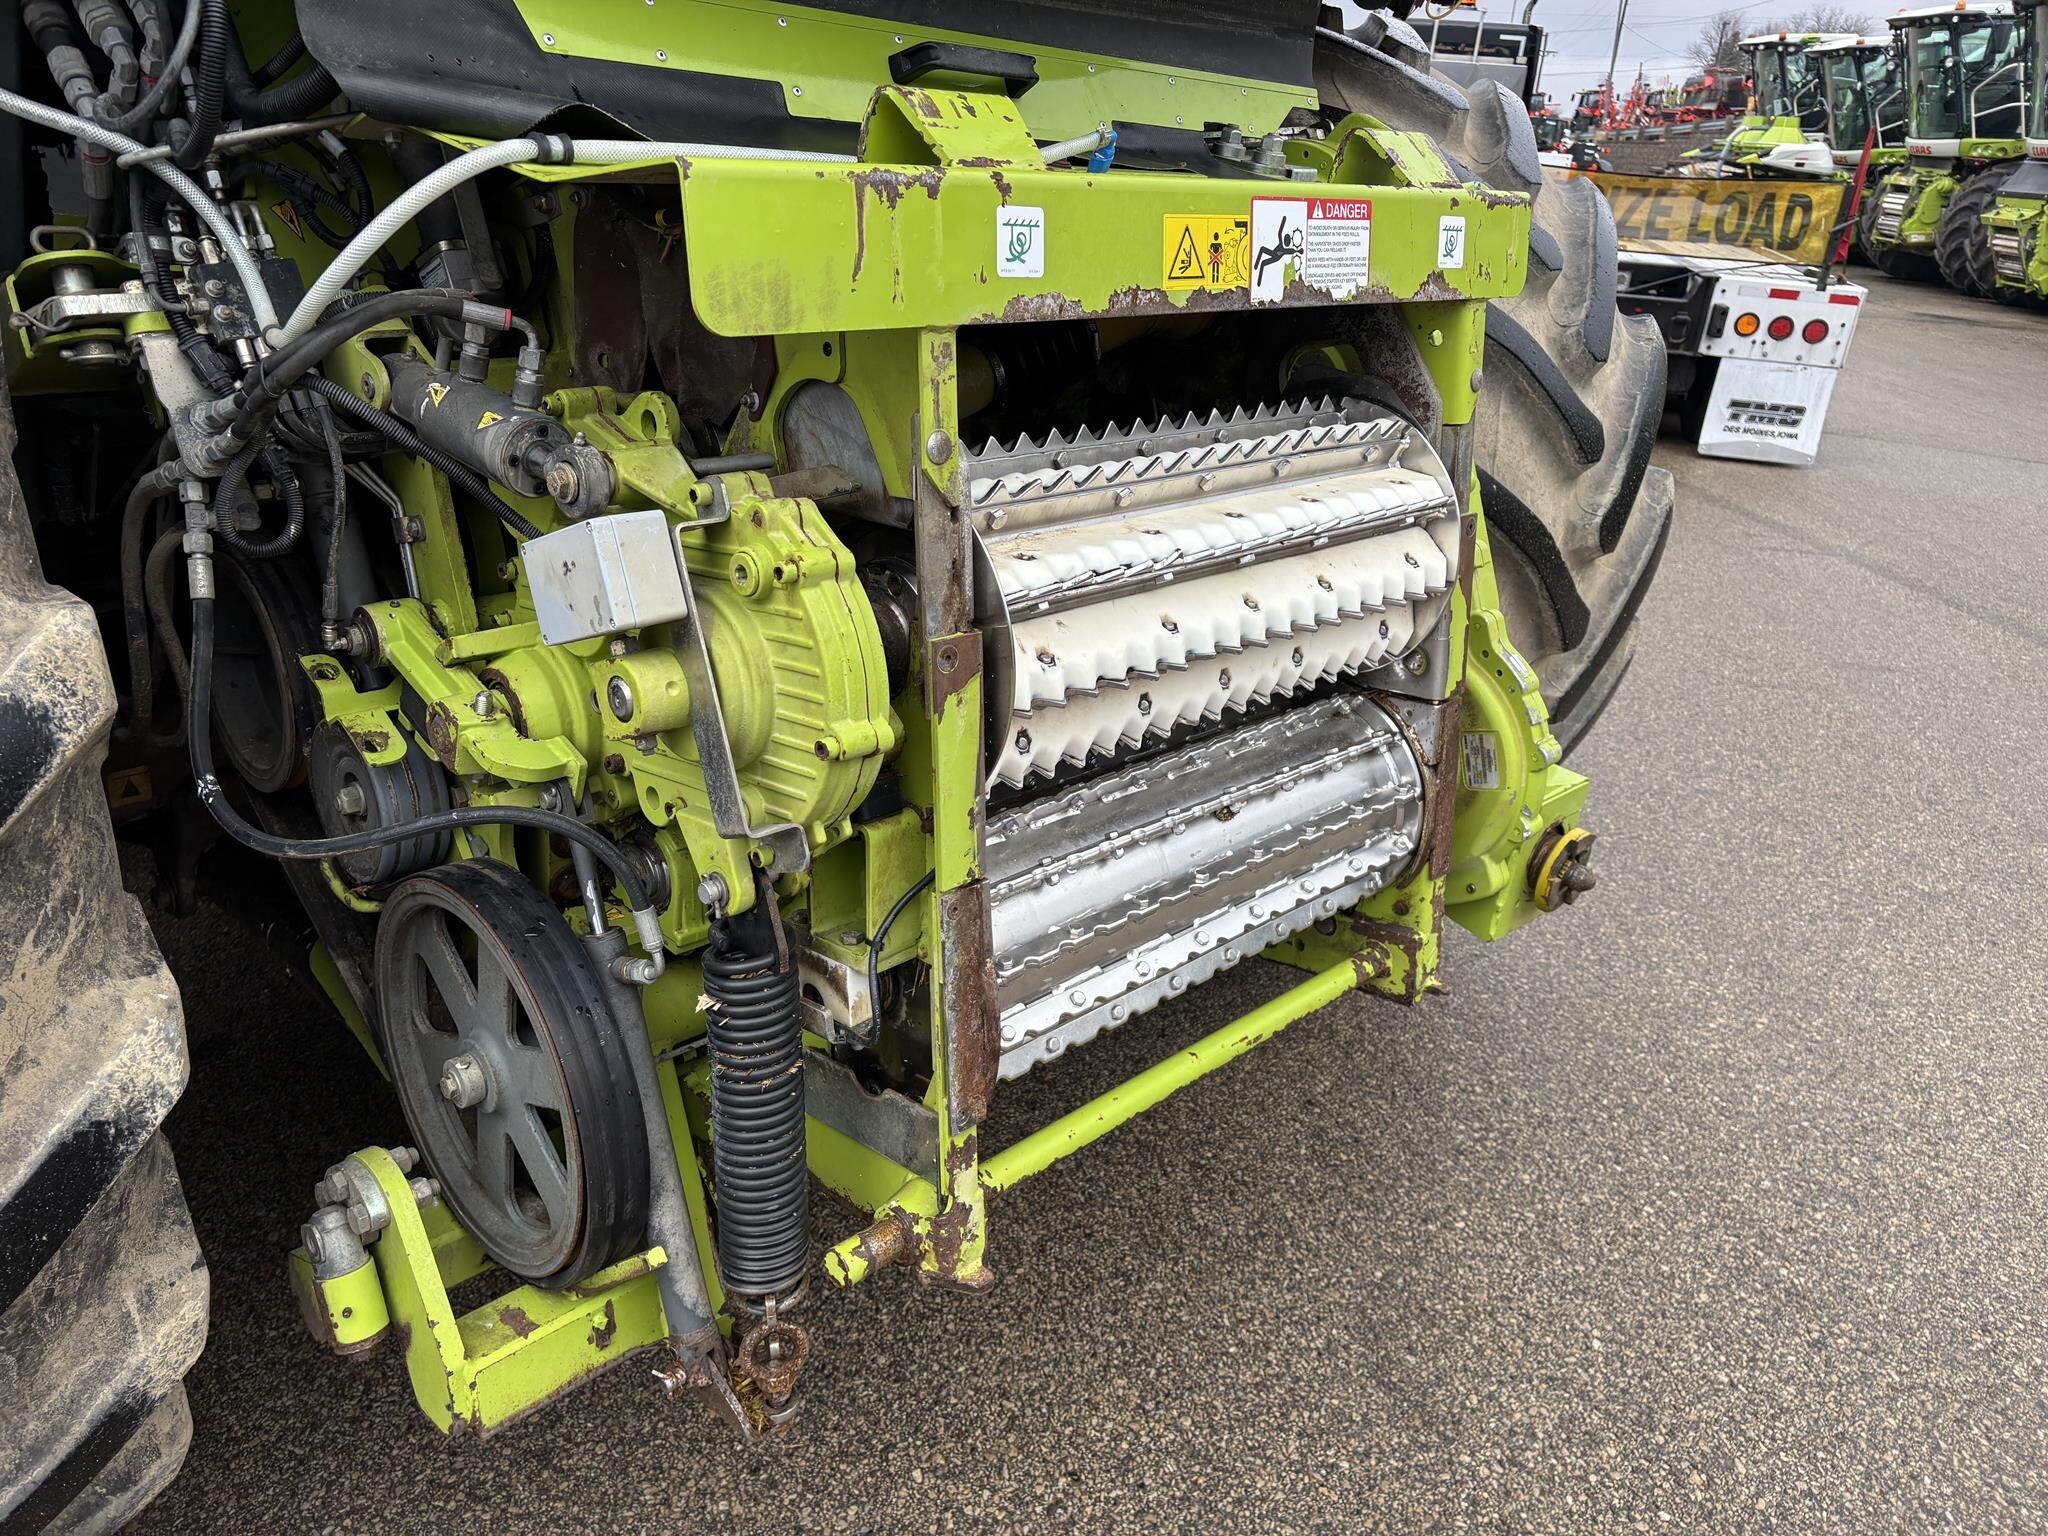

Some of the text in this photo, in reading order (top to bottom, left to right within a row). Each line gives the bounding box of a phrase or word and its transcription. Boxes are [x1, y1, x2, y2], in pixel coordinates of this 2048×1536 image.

[1910, 146, 1932, 155] CLAAS
[1326, 203, 1368, 218] DANGER
[1600, 185, 1812, 250] IZE LOAD
[1727, 399, 1807, 427] TMC
[1723, 425, 1741, 433] DES
[1777, 430, 1799, 440] IOWA
